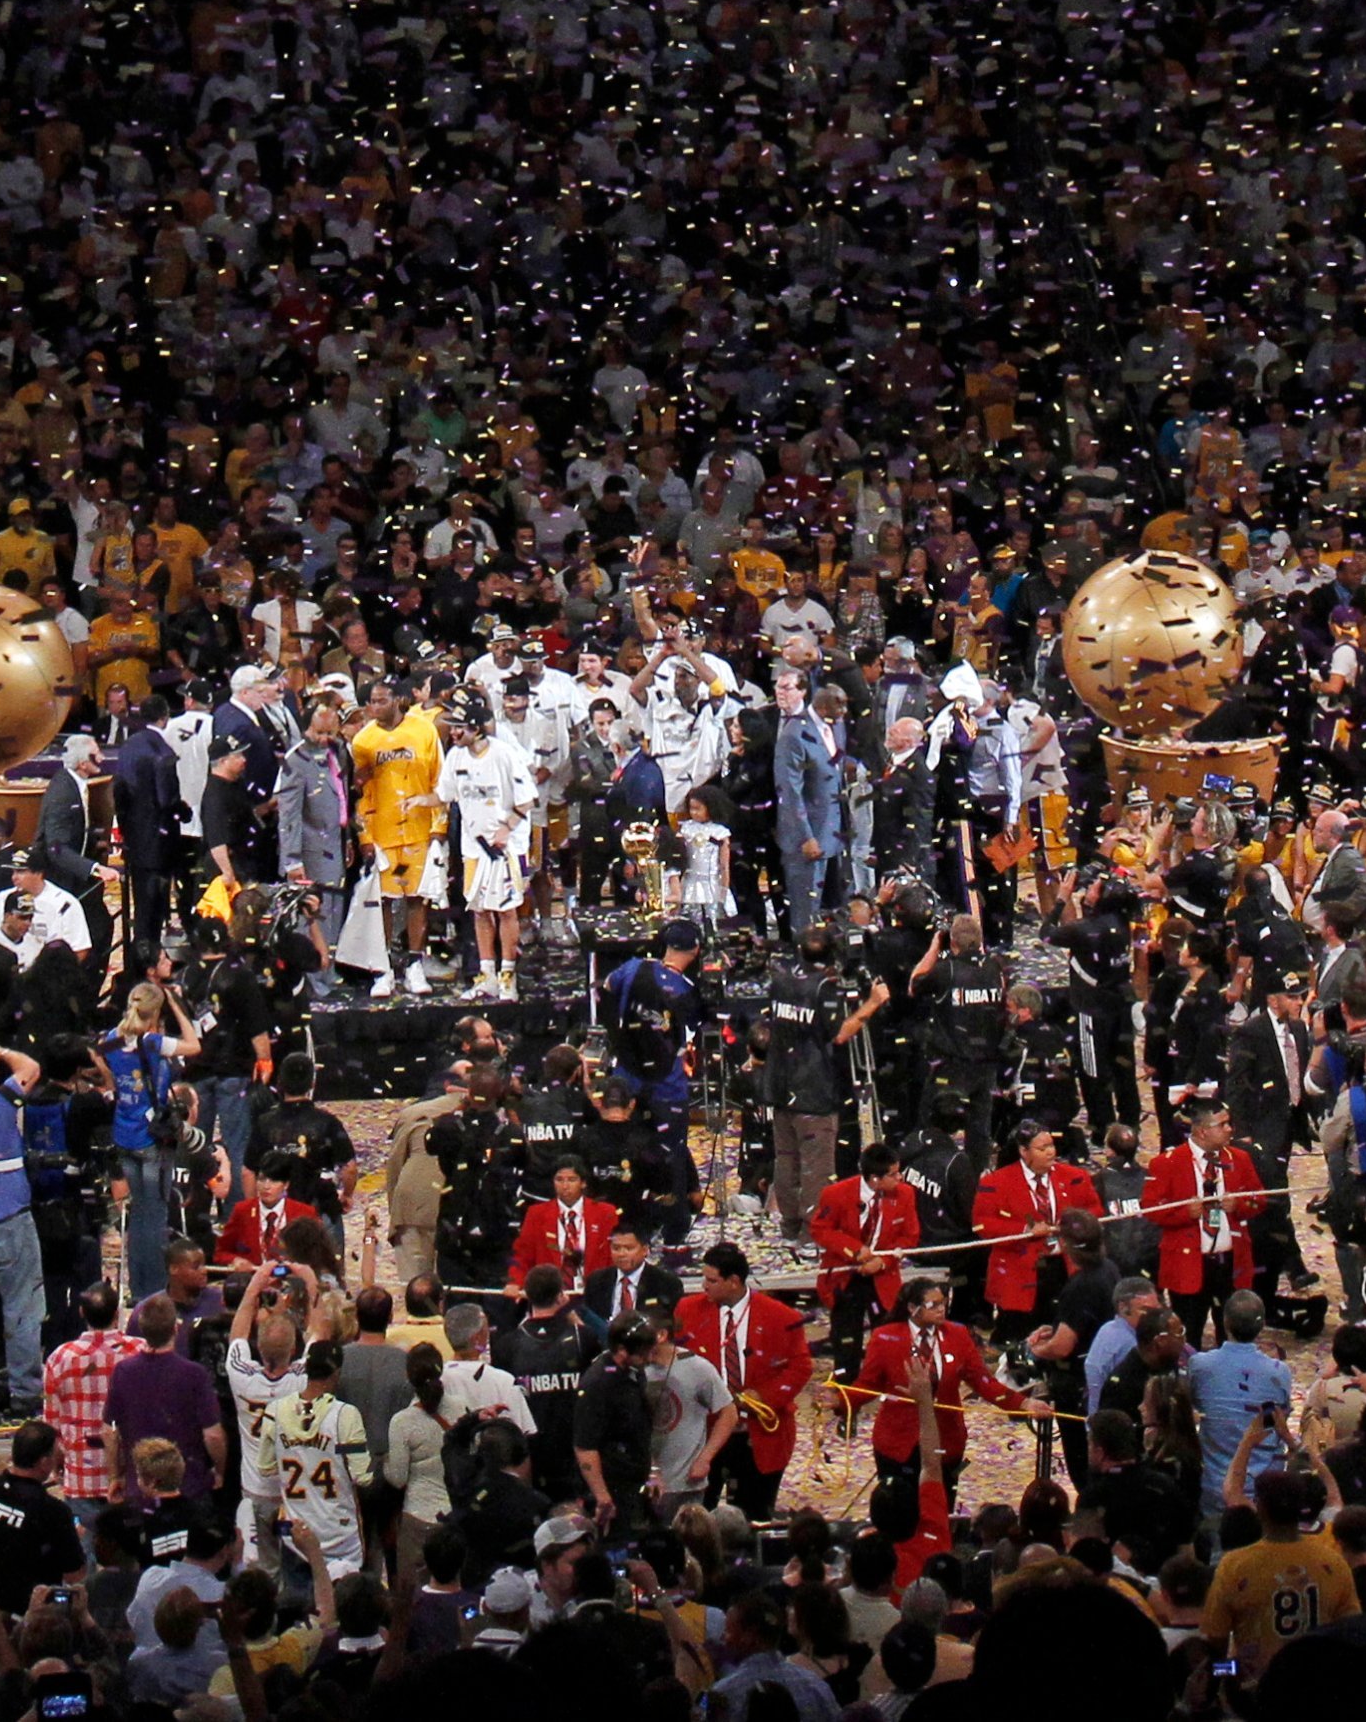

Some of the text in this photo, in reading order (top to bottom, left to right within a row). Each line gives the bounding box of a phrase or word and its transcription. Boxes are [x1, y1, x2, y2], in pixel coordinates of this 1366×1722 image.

[965, 987, 989, 1004] NBA
[777, 1002, 815, 1024] NBA TV
[527, 1123, 575, 1142] NBA TV
[906, 1167, 942, 1199] NBA TV
[531, 1372, 580, 1393] NBA TV
[281, 1457, 337, 1500] 24
[1272, 1583, 1319, 1639] 81
